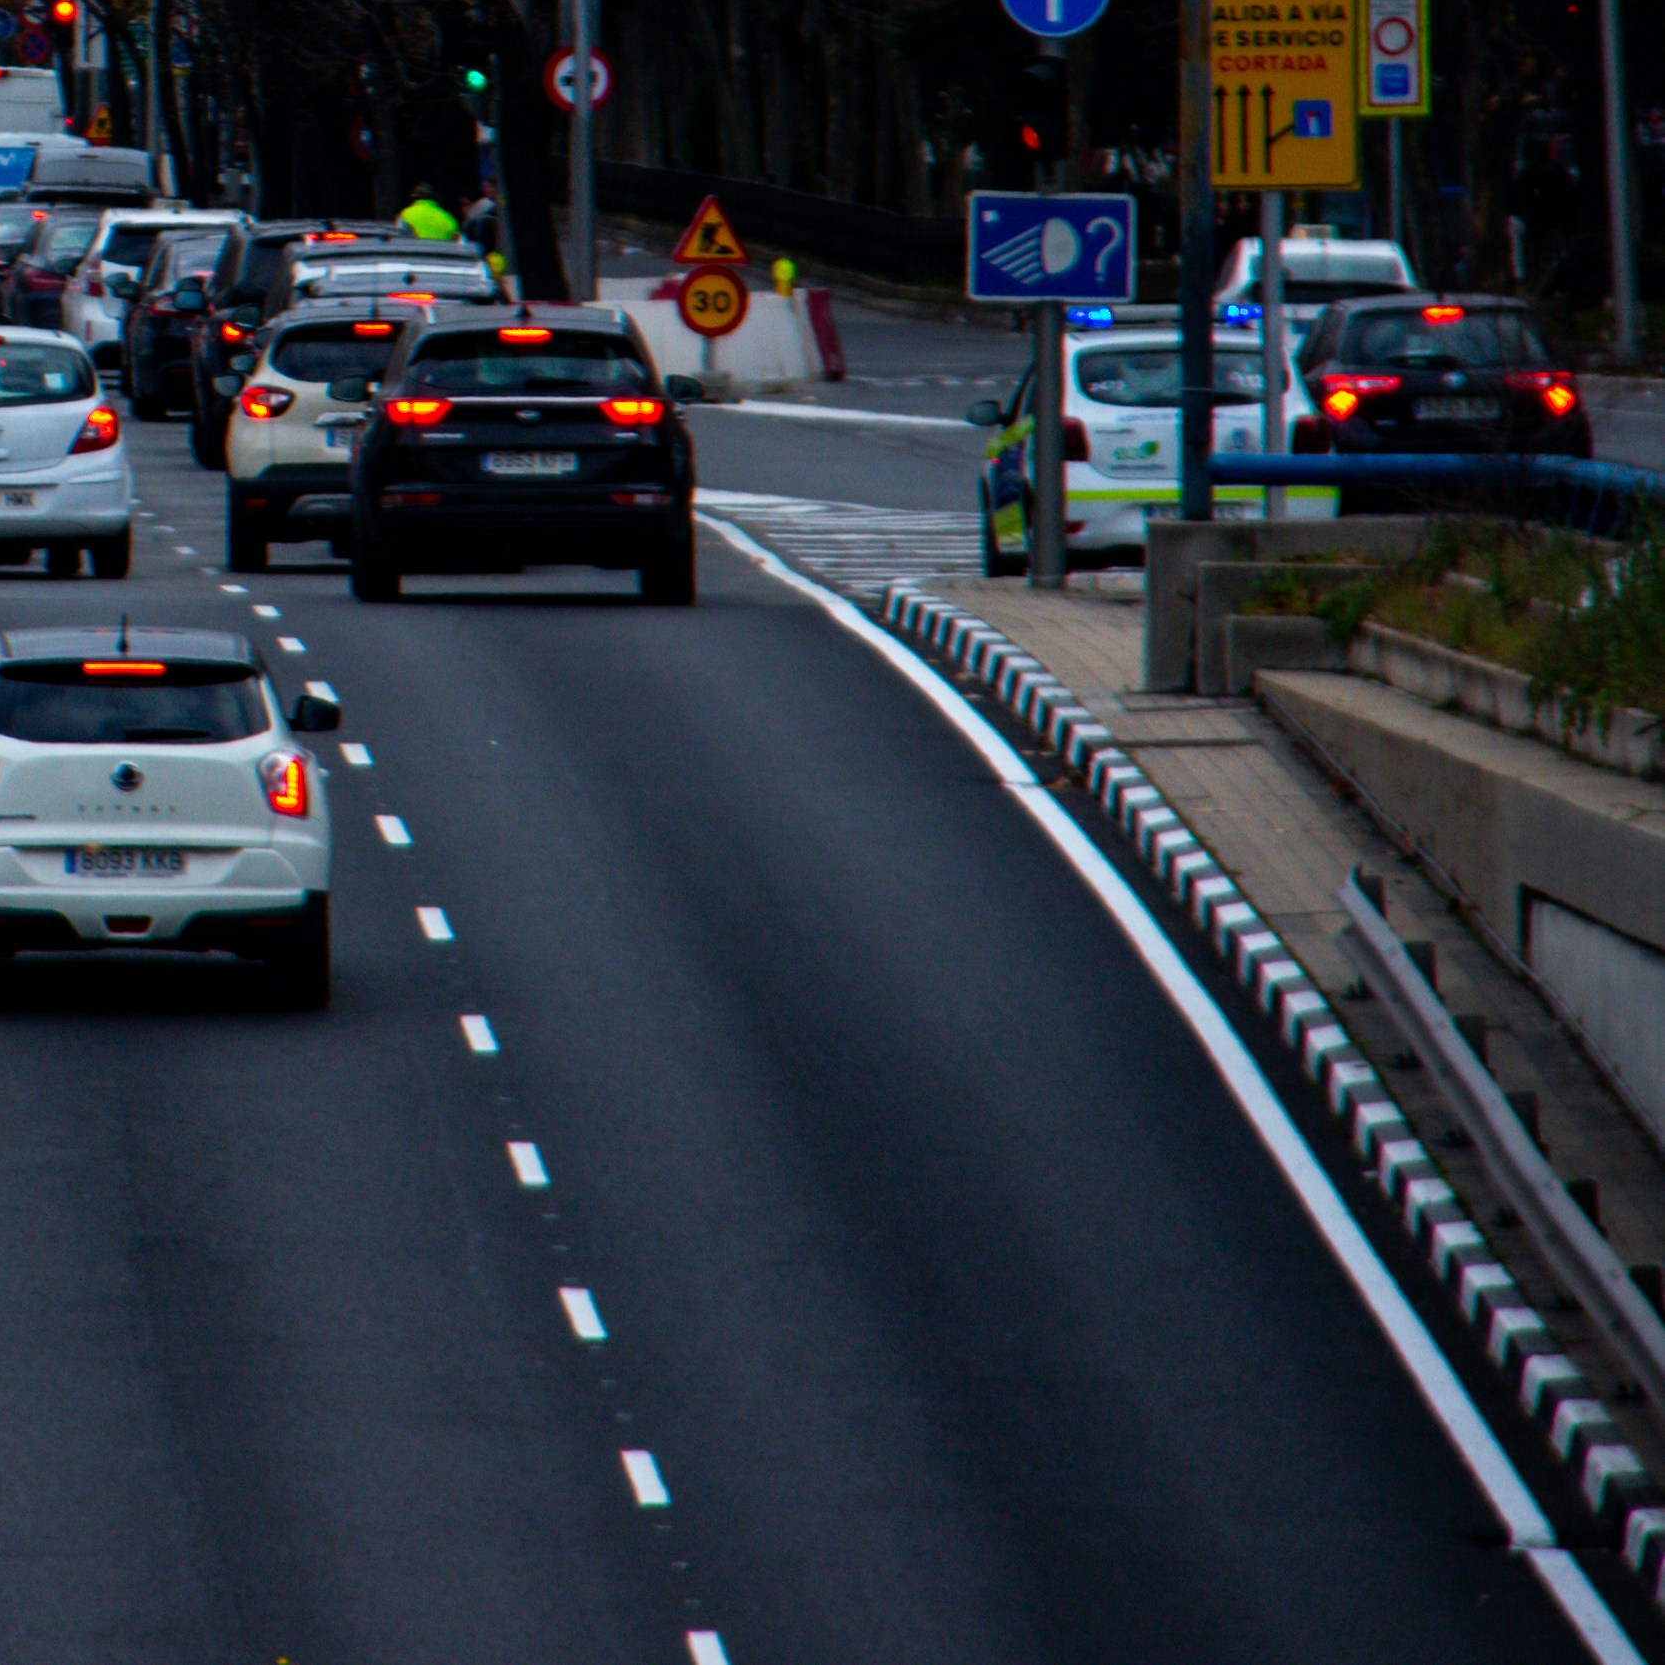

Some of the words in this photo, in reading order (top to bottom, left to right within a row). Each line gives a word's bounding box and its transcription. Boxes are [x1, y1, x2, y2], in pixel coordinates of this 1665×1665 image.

[1213, 5, 1281, 22] ALIDA
[1288, 5, 1304, 22] A
[1215, 30, 1229, 47] E
[1235, 30, 1345, 47] SERVICIO
[1219, 54, 1328, 73] CORTADA
[691, 289, 731, 314] 30
[81, 850, 135, 870] 8093
